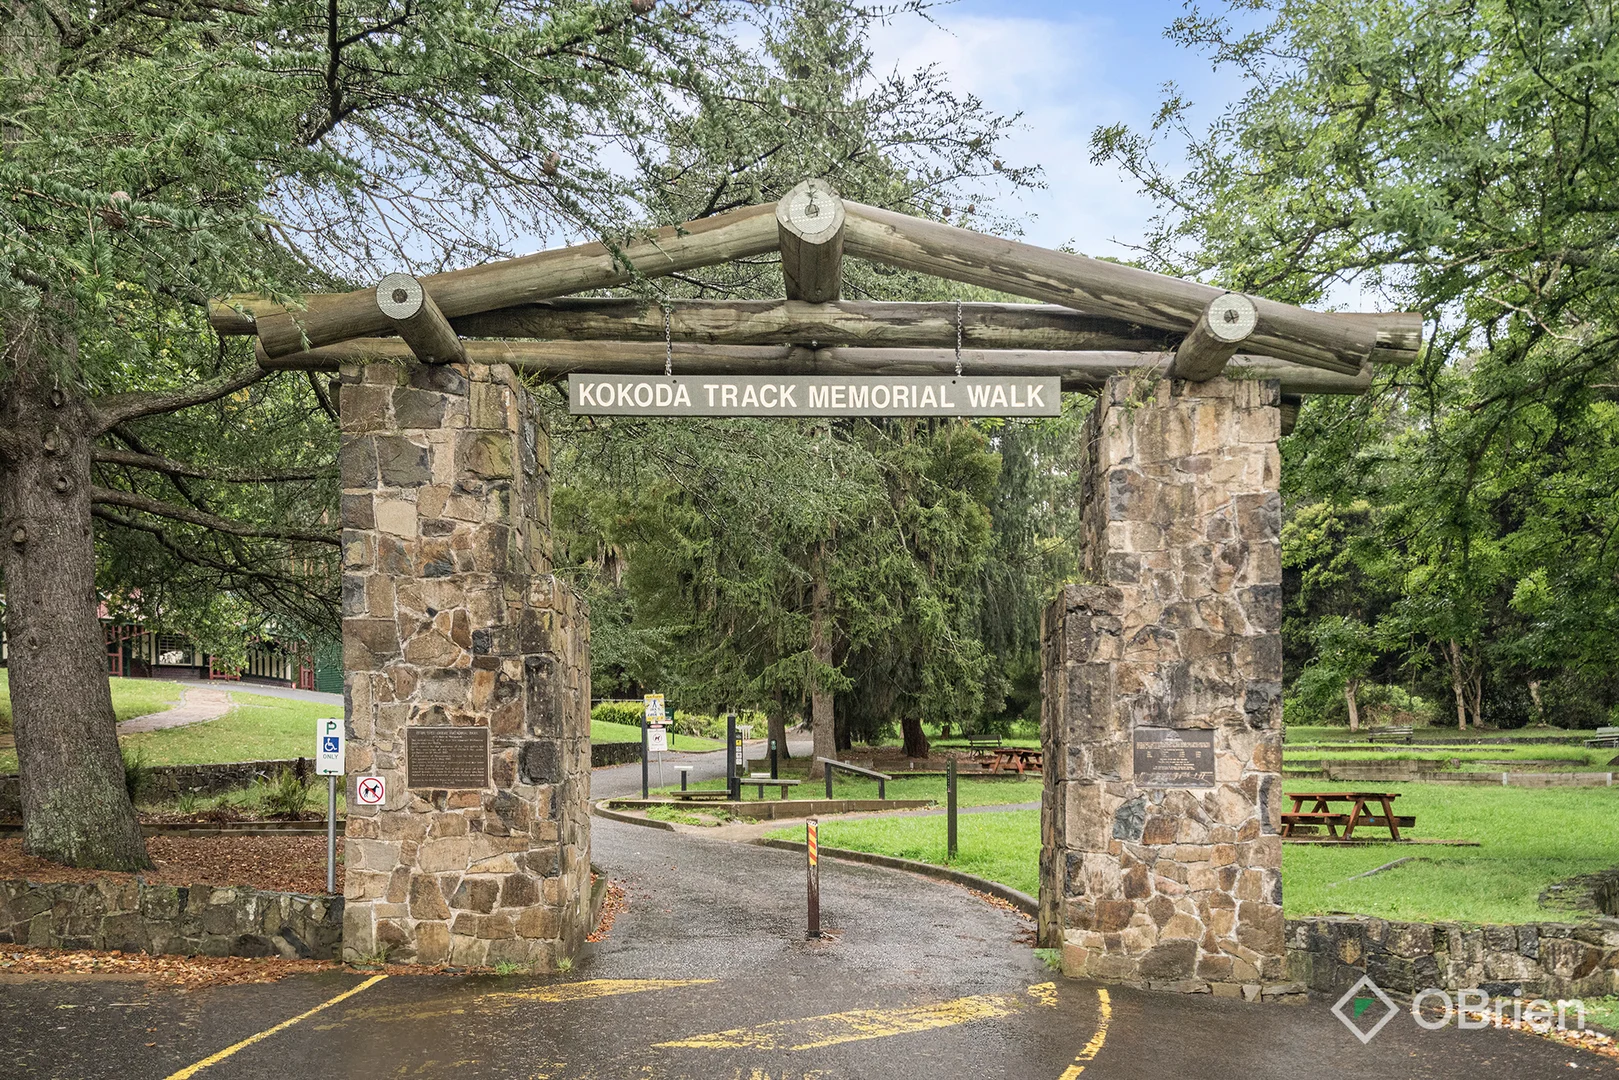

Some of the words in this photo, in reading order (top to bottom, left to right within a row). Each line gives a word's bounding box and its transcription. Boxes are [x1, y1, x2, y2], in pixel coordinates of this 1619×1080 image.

[578, 382, 692, 408] KOKODA
[703, 383, 798, 408] TRACK
[808, 383, 956, 409] MEMORIAL
[965, 383, 1046, 408] WALK
[326, 721, 337, 735] P
